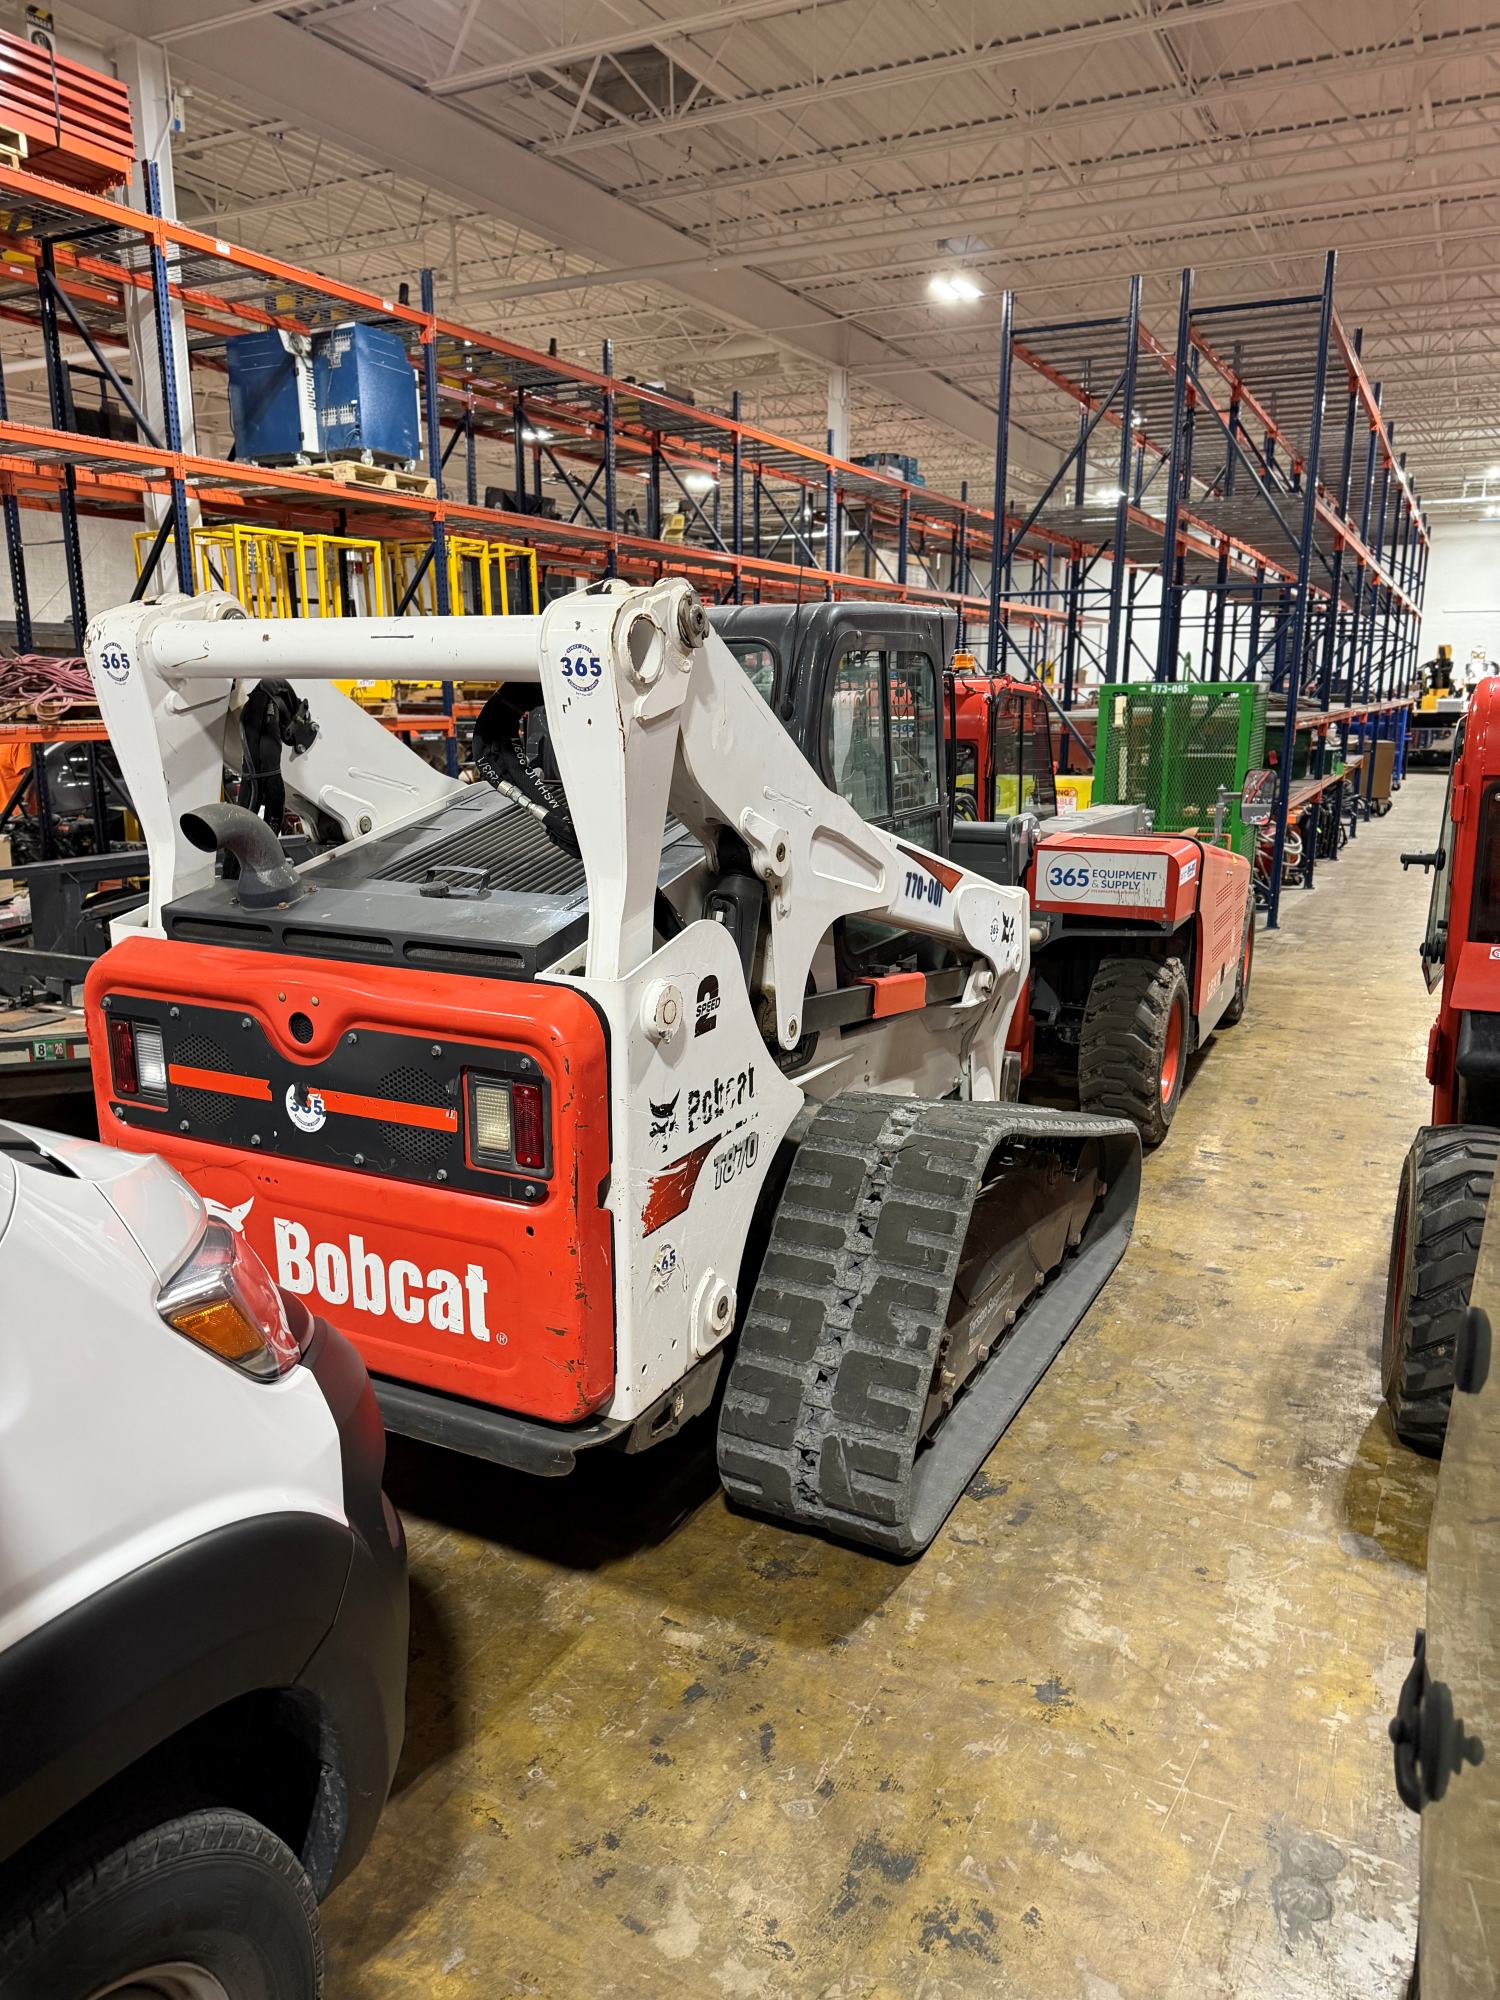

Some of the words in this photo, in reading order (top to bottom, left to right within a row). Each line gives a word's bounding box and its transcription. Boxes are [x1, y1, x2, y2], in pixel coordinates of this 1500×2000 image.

[100, 653, 130, 670] 365
[560, 656, 602, 677] 365
[1050, 867, 1090, 887] 365
[1092, 869, 1158, 881] EQUIPMENT
[1091, 880, 1099, 888] &
[1100, 880, 1141, 890] SUPPLY
[696, 997, 721, 1018] SPEED
[38, 1044, 45, 1056] 8
[54, 1043, 64, 1055] 26
[714, 1131, 760, 1190] T870
[273, 1216, 491, 1343] Bobcat
